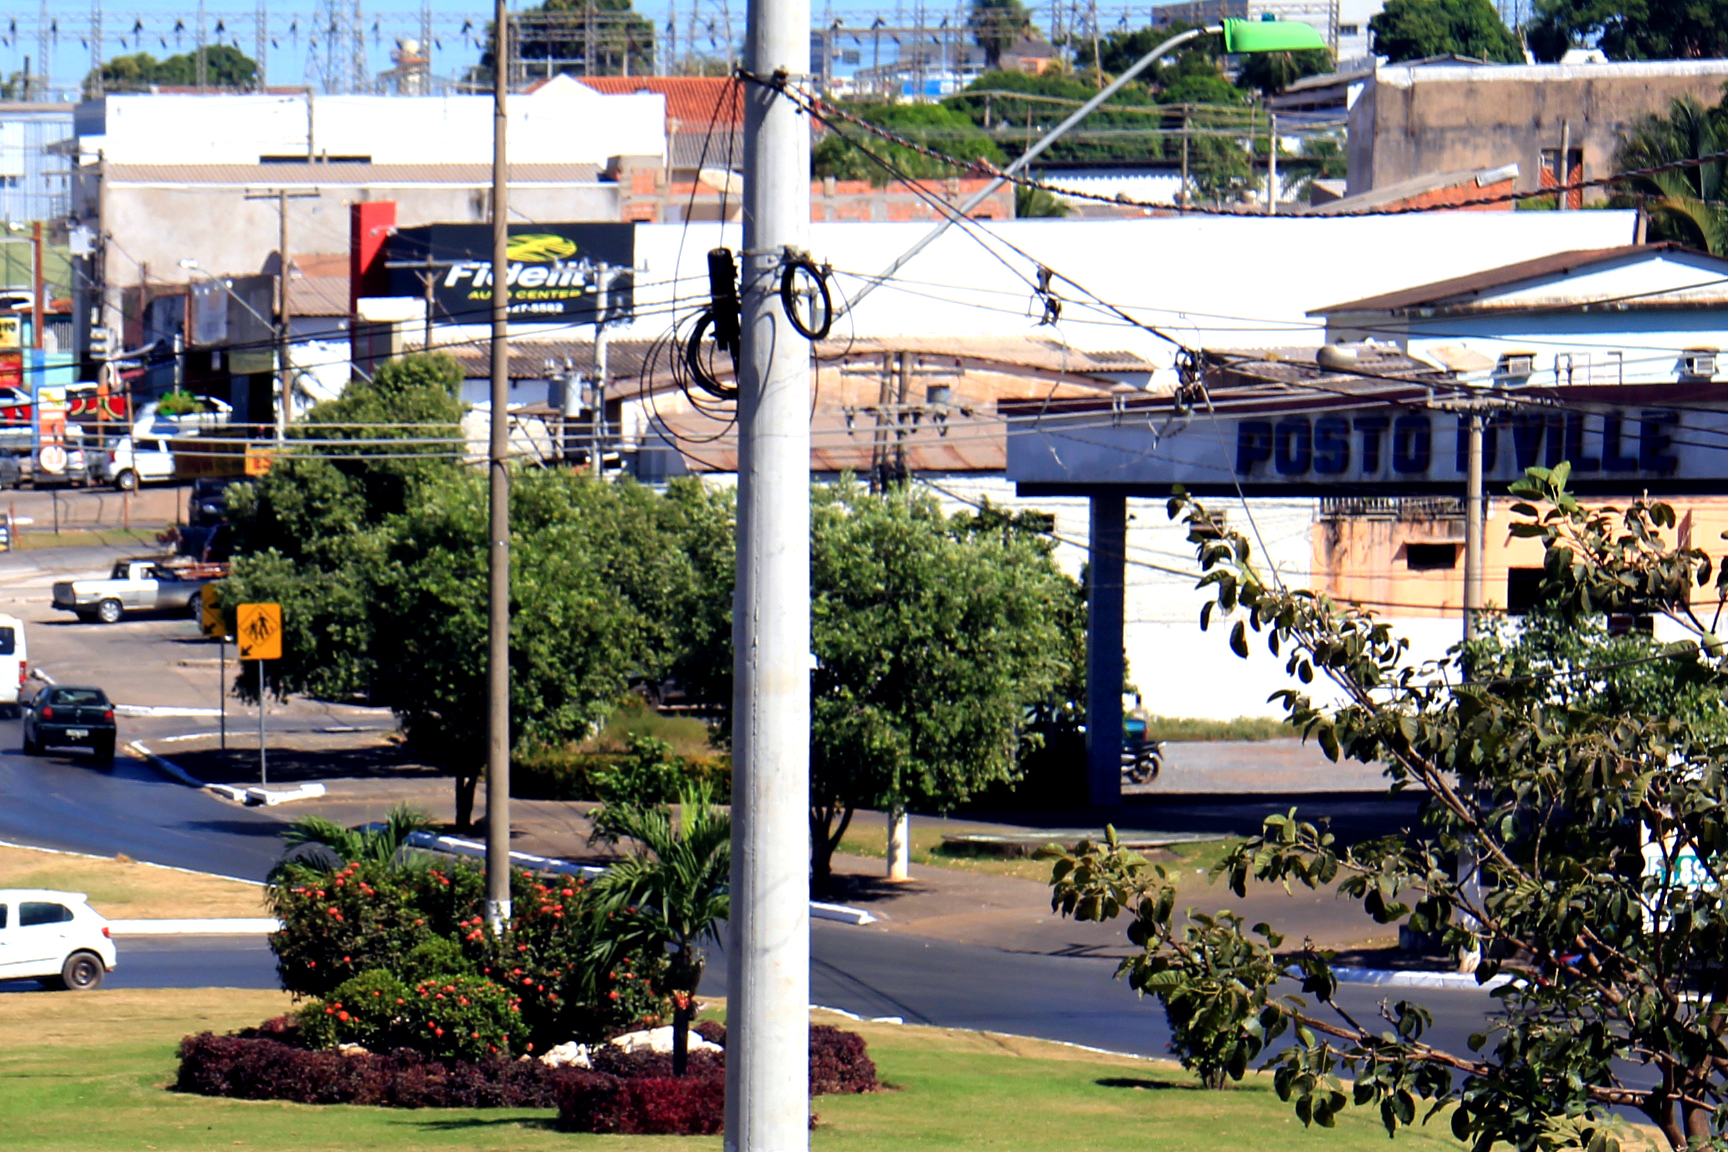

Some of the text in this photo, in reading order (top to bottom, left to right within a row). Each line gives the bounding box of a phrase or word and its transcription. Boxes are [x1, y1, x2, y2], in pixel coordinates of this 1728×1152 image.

[467, 288, 582, 300] AU CENTER
[1236, 411, 1432, 476] POSTO
